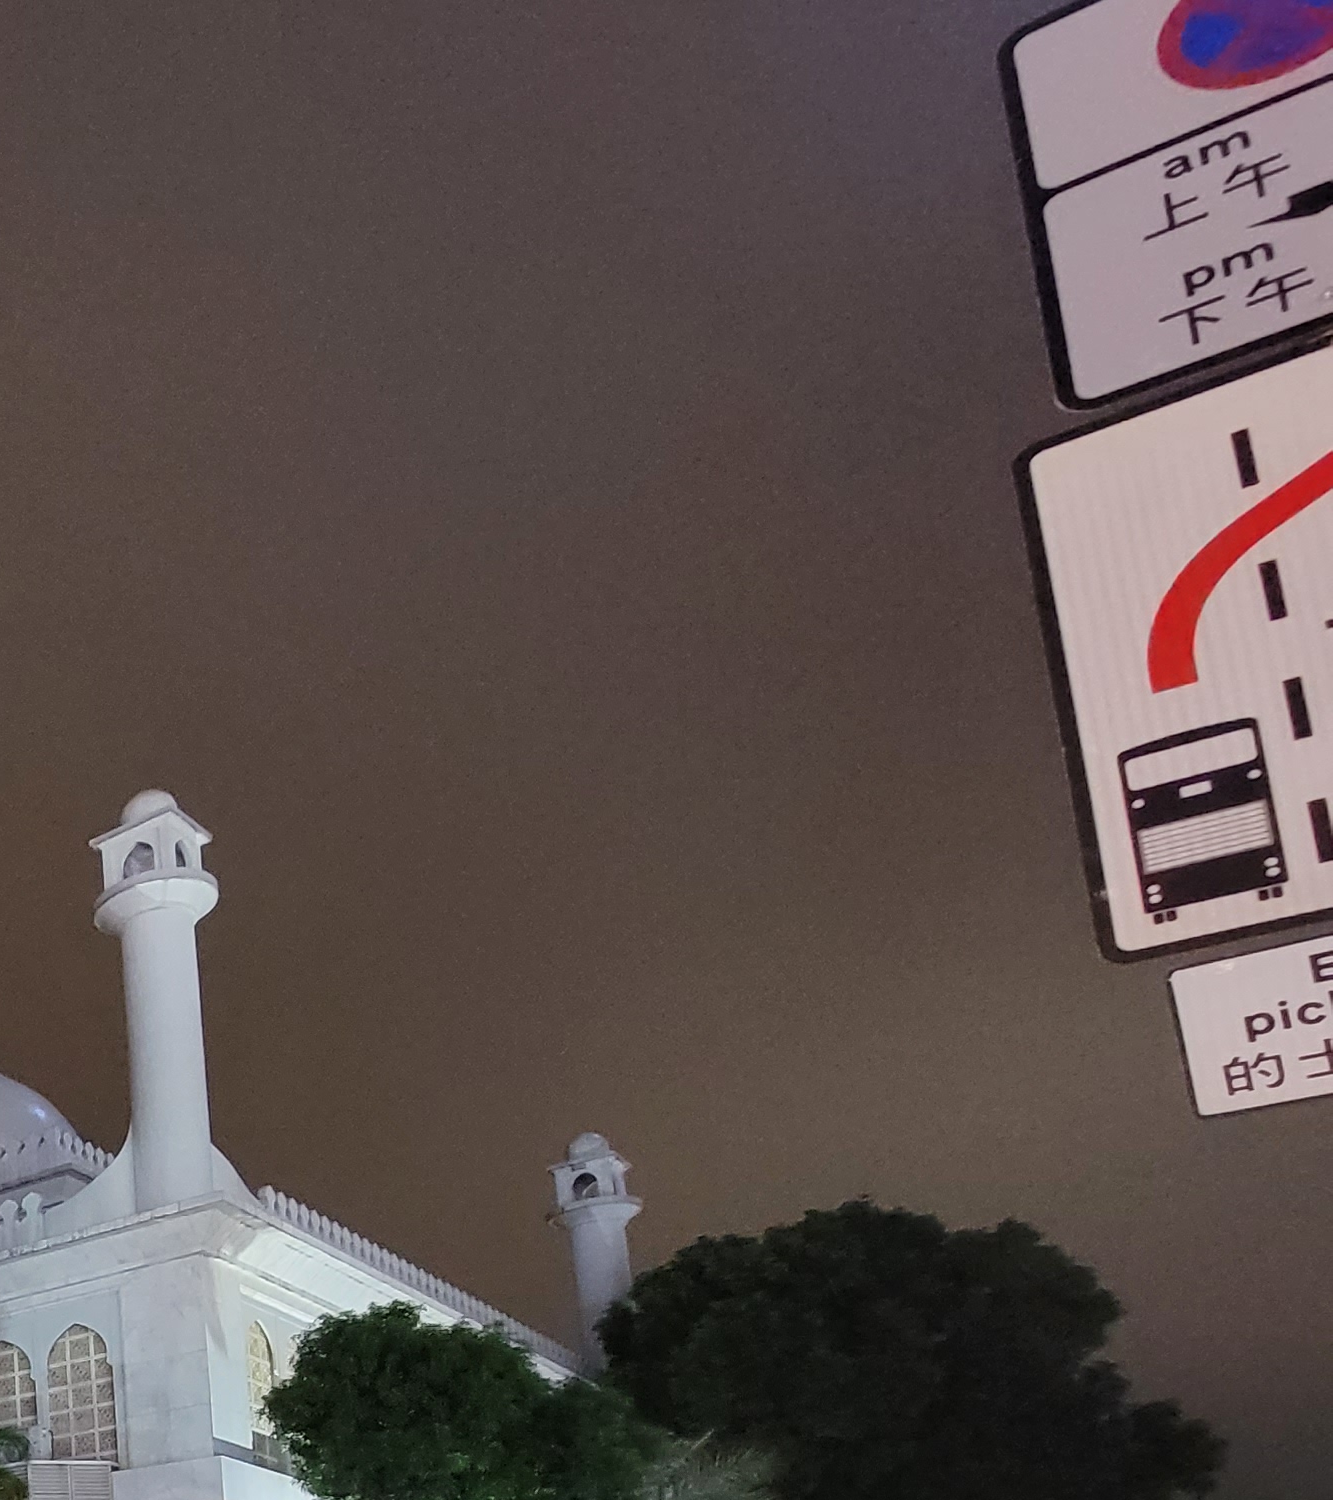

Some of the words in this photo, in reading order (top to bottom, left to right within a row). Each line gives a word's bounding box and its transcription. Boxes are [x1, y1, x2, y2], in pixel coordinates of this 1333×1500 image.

[1163, 131, 1251, 179] am
[1142, 153, 1291, 241] 上午
[1182, 242, 1274, 297] pm
[1158, 266, 1315, 345] 下午
[1244, 990, 1333, 1043] pic
